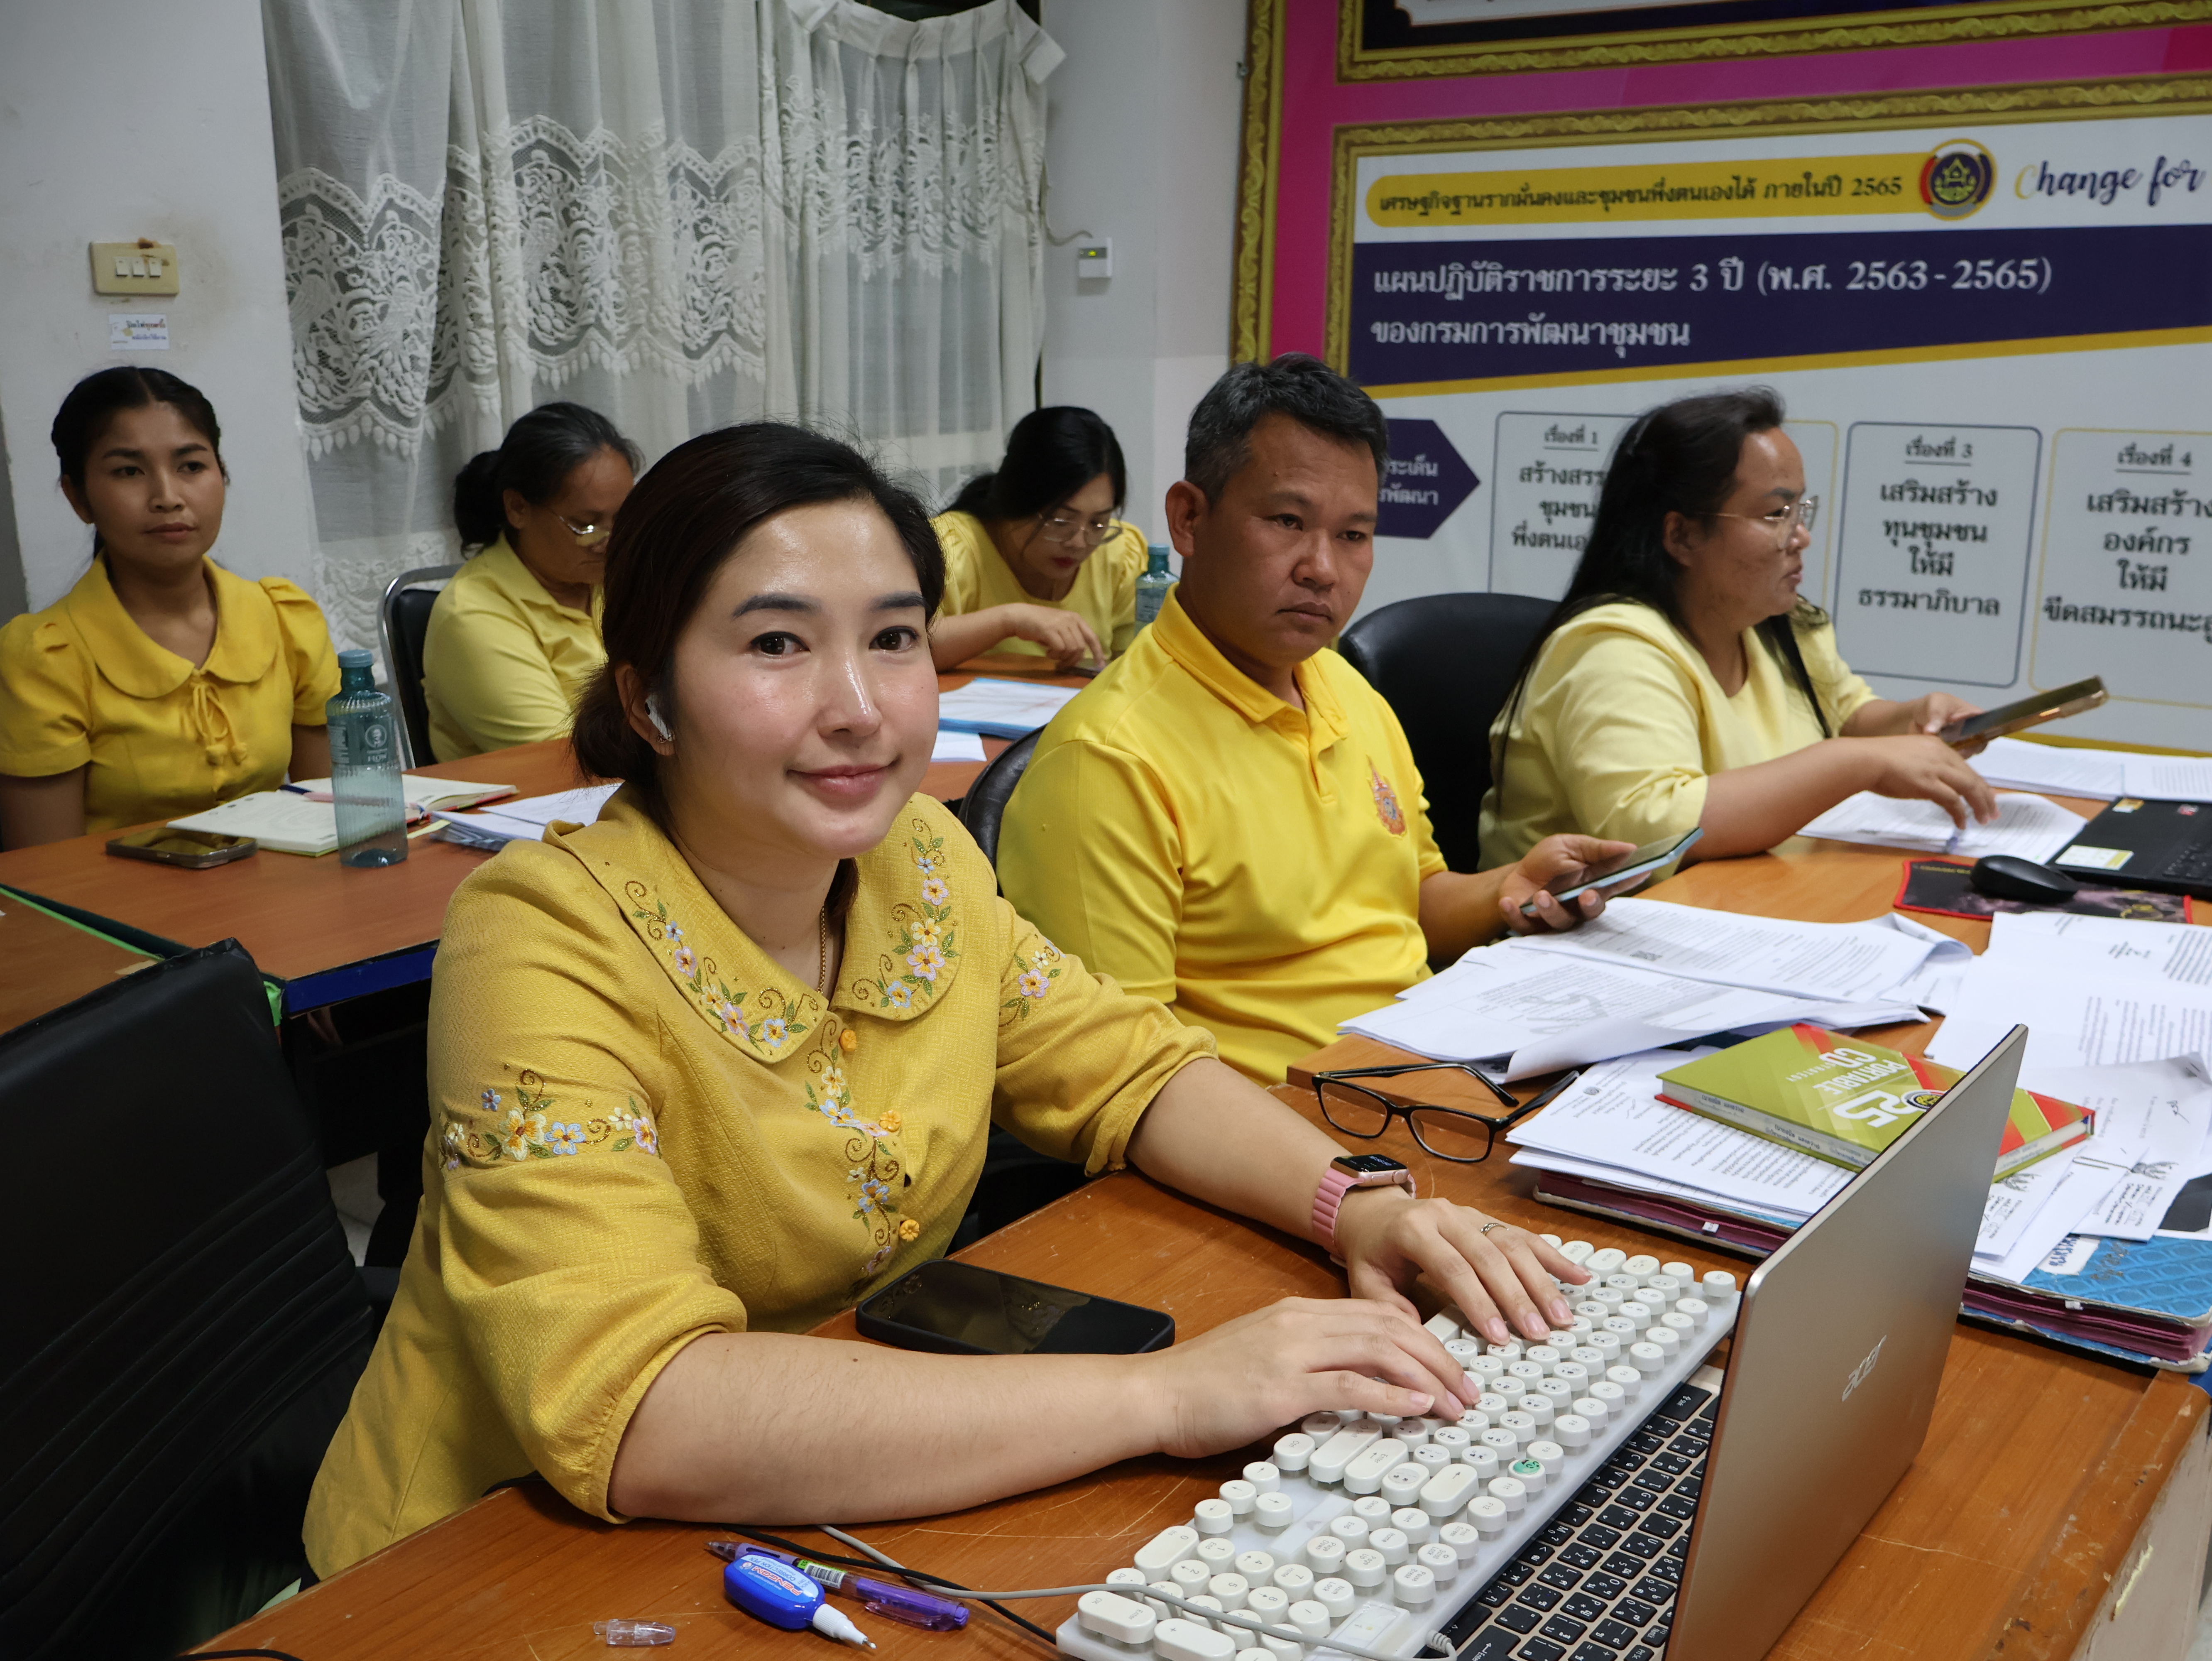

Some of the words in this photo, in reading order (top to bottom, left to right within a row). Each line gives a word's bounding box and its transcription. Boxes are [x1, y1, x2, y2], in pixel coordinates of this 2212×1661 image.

[1851, 176, 1902, 197] 2565
[2014, 160, 2141, 205] Change
[2145, 155, 2206, 207] for
[1374, 260, 1678, 300] แผนปฏิบัติราชการระยะ
[1689, 263, 1708, 292] 3
[1720, 256, 1745, 292] ปี
[1757, 261, 1832, 296] (พ.ศ.
[1370, 312, 1691, 359] ของกรมการพัฒนาชุมชน
[1592, 431, 1598, 444] 1
[1962, 443, 1973, 458] 3
[2179, 451, 2192, 468] 4
[1880, 480, 1998, 507] เสริมสร้าง
[1883, 517, 1987, 547] ทุนชุมชน
[2104, 526, 2190, 556] องค์กร
[1909, 547, 1955, 577] ให้มี
[2117, 560, 2168, 591] ให้มี
[1859, 587, 2001, 617] ธรรมาภิบาล
[1819, 1048, 1877, 1068] CD
[1812, 1059, 1909, 1095] PORTABLE
[1343, 1521, 1355, 1529] End
[1315, 1540, 1330, 1550] Down
[1323, 1542, 1337, 1552] Page
[1381, 1532, 1396, 1543] Home
[1363, 1555, 1376, 1565] Page
[751, 1566, 803, 1596] PENCOM
[761, 1561, 796, 1581] CORRECTION
[1322, 1581, 1336, 1591] Lock
